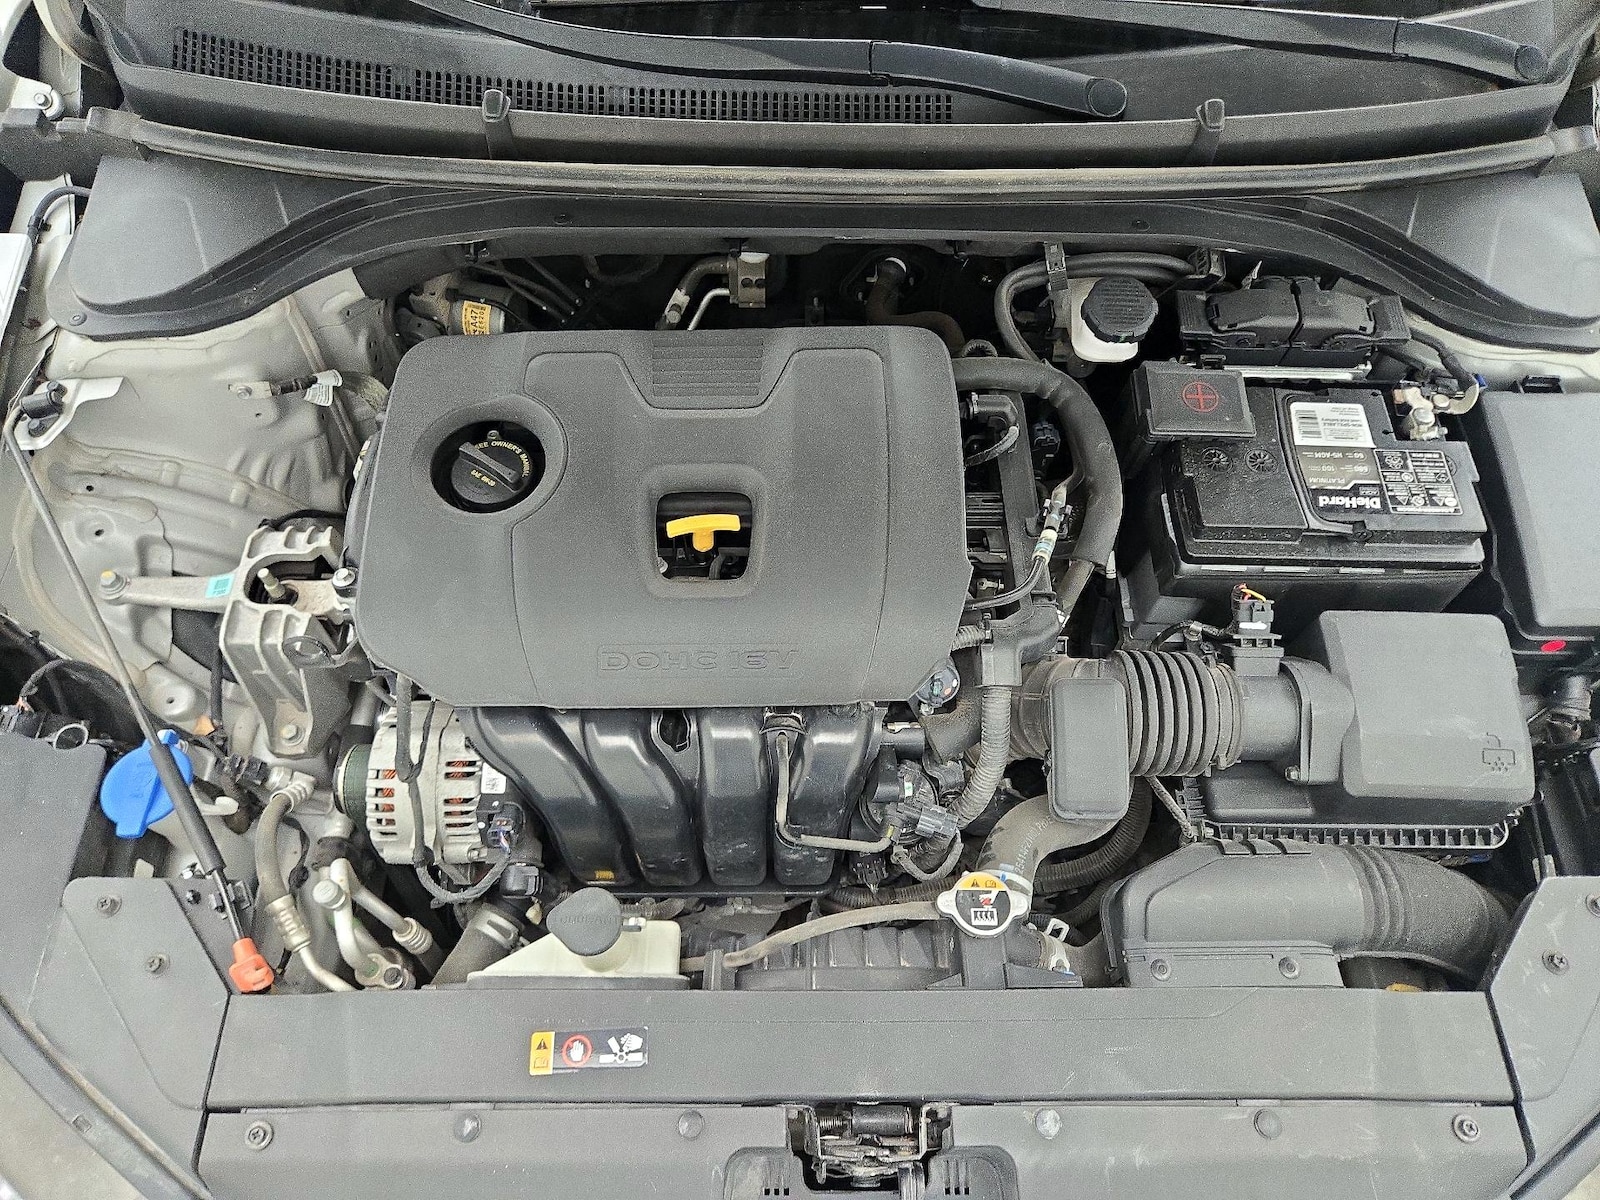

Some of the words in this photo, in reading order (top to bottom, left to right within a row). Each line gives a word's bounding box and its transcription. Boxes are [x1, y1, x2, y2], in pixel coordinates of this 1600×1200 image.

[491, 441, 522, 455] OWNER'S
[1319, 495, 1381, 509] DieHard
[599, 651, 718, 671] DOHC
[731, 649, 800, 670] 16V
